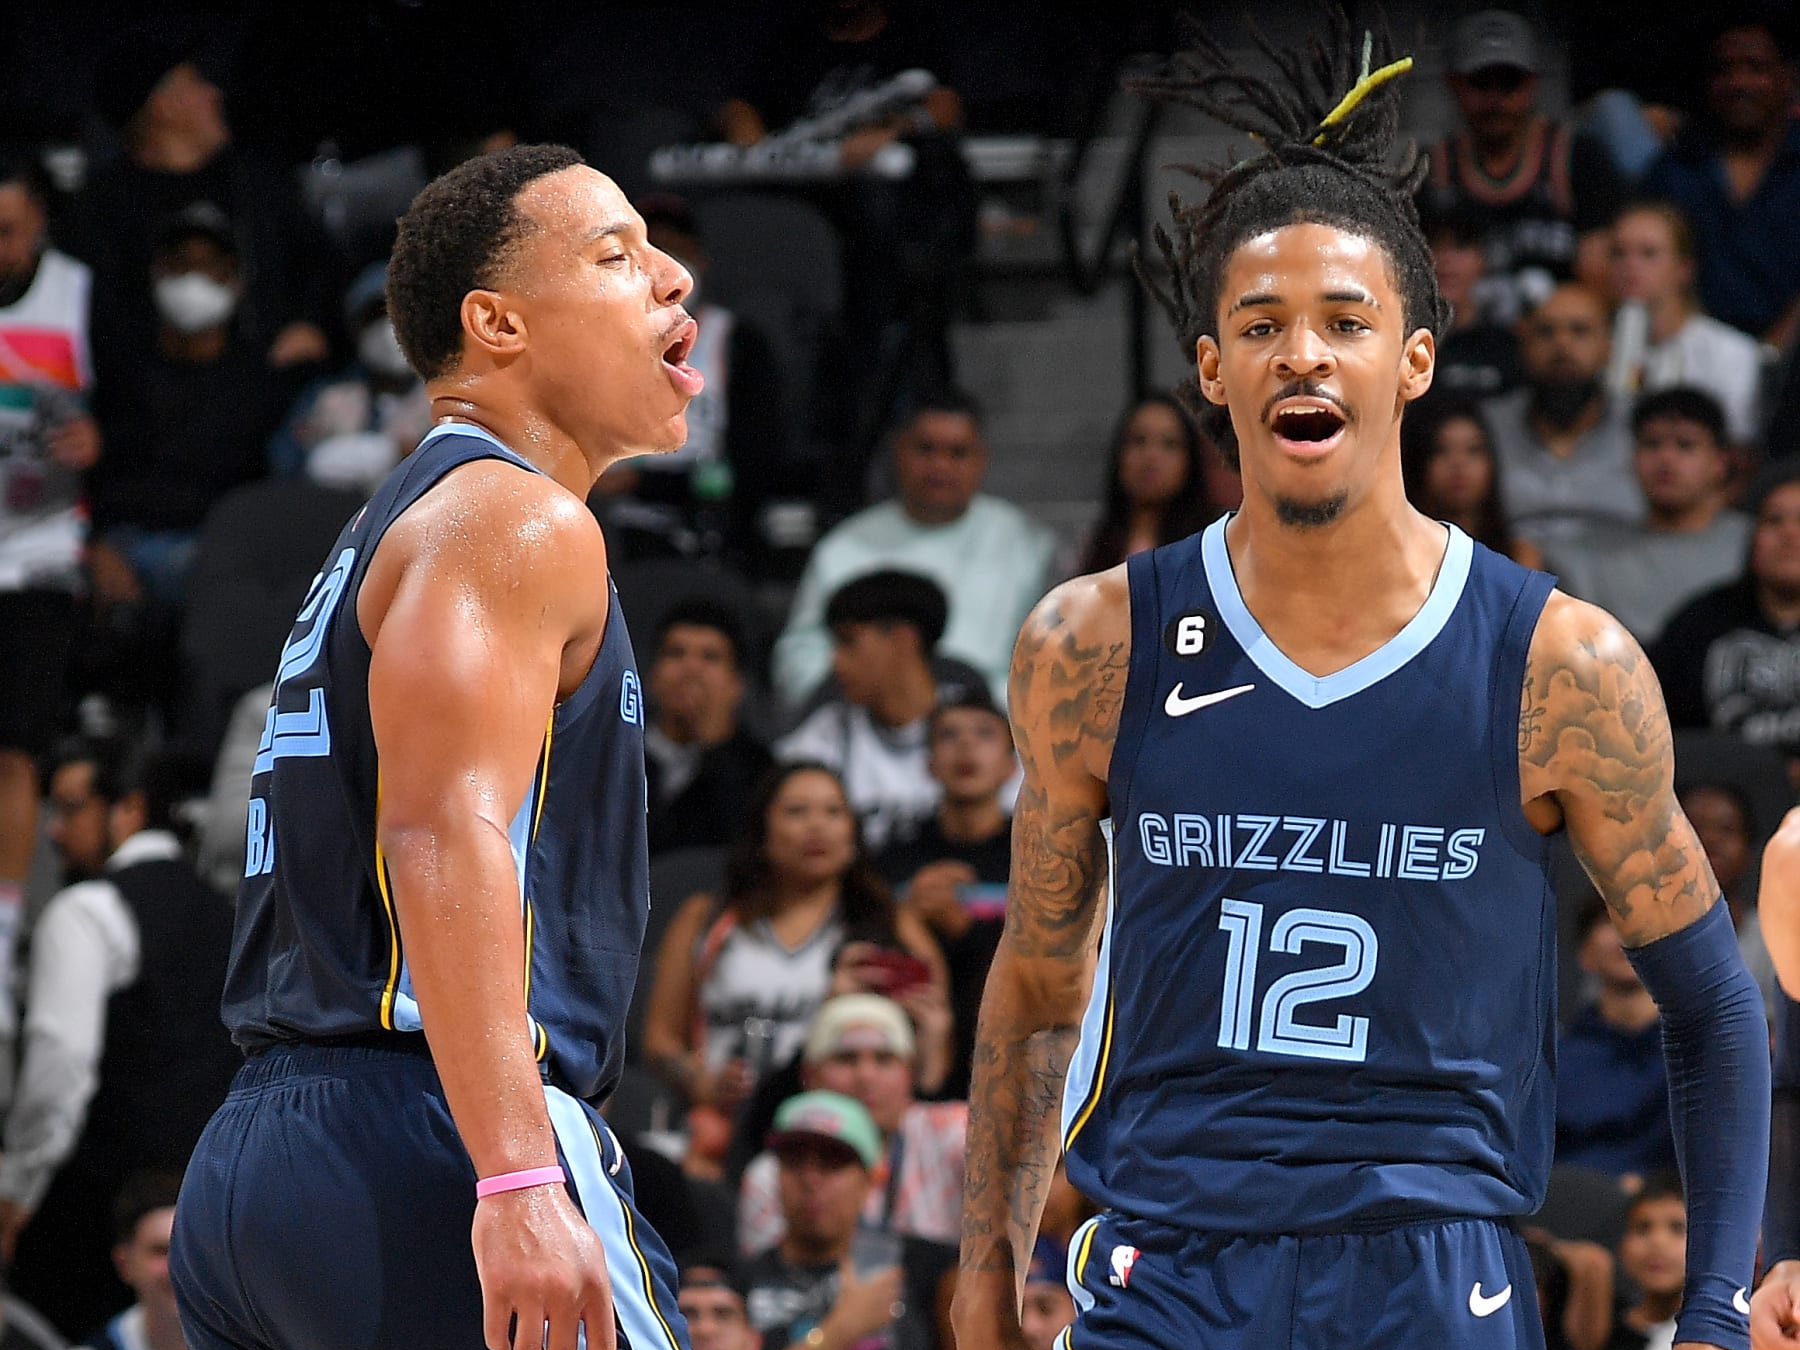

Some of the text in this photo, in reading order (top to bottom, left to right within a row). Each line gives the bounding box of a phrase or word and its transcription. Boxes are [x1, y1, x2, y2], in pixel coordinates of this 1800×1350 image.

[1176, 615, 1205, 655] 6
[1138, 812, 1486, 880] GRIZZLIES
[1217, 898, 1378, 1062] 12
